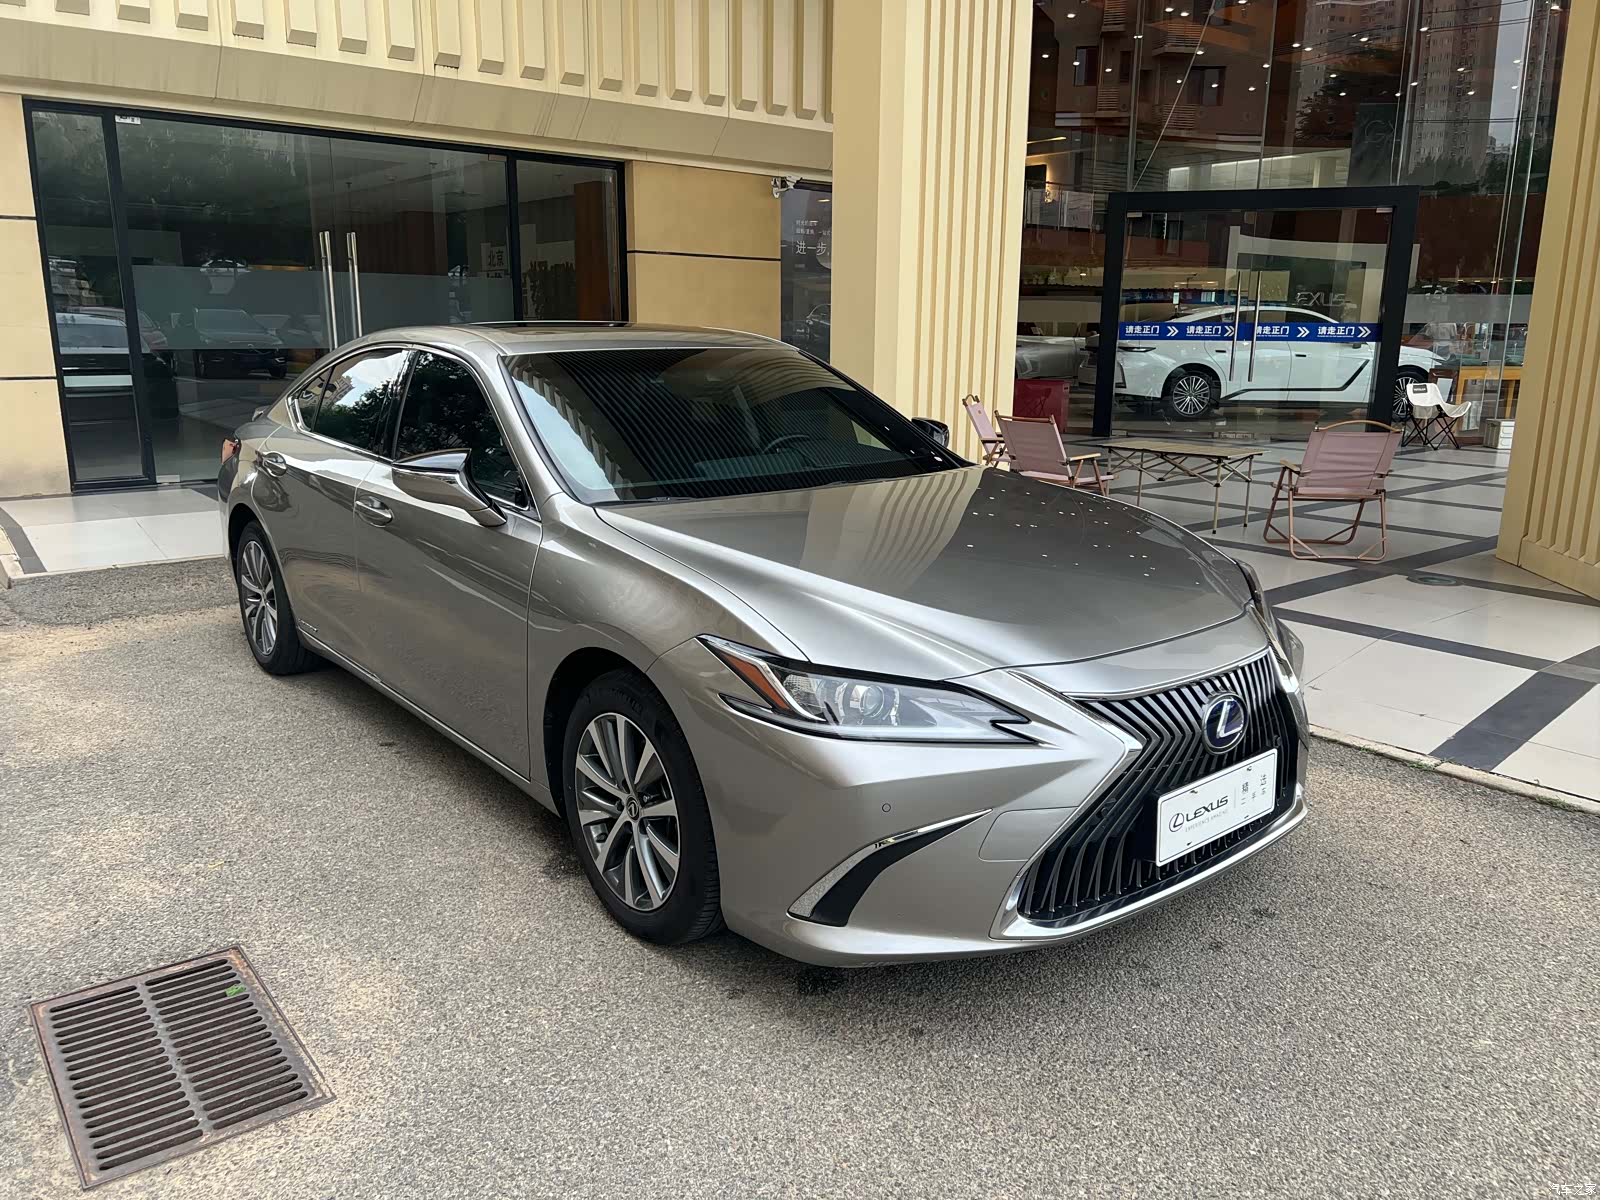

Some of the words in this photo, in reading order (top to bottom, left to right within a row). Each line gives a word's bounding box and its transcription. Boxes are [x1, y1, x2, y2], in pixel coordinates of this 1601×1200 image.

[488, 248, 504, 268] 北京
[1125, 325, 1160, 334] 请走正门
[1186, 325, 1221, 334] 请走正门
[1318, 326, 1355, 335] 请走正门
[1186, 795, 1229, 822] LEXUS
